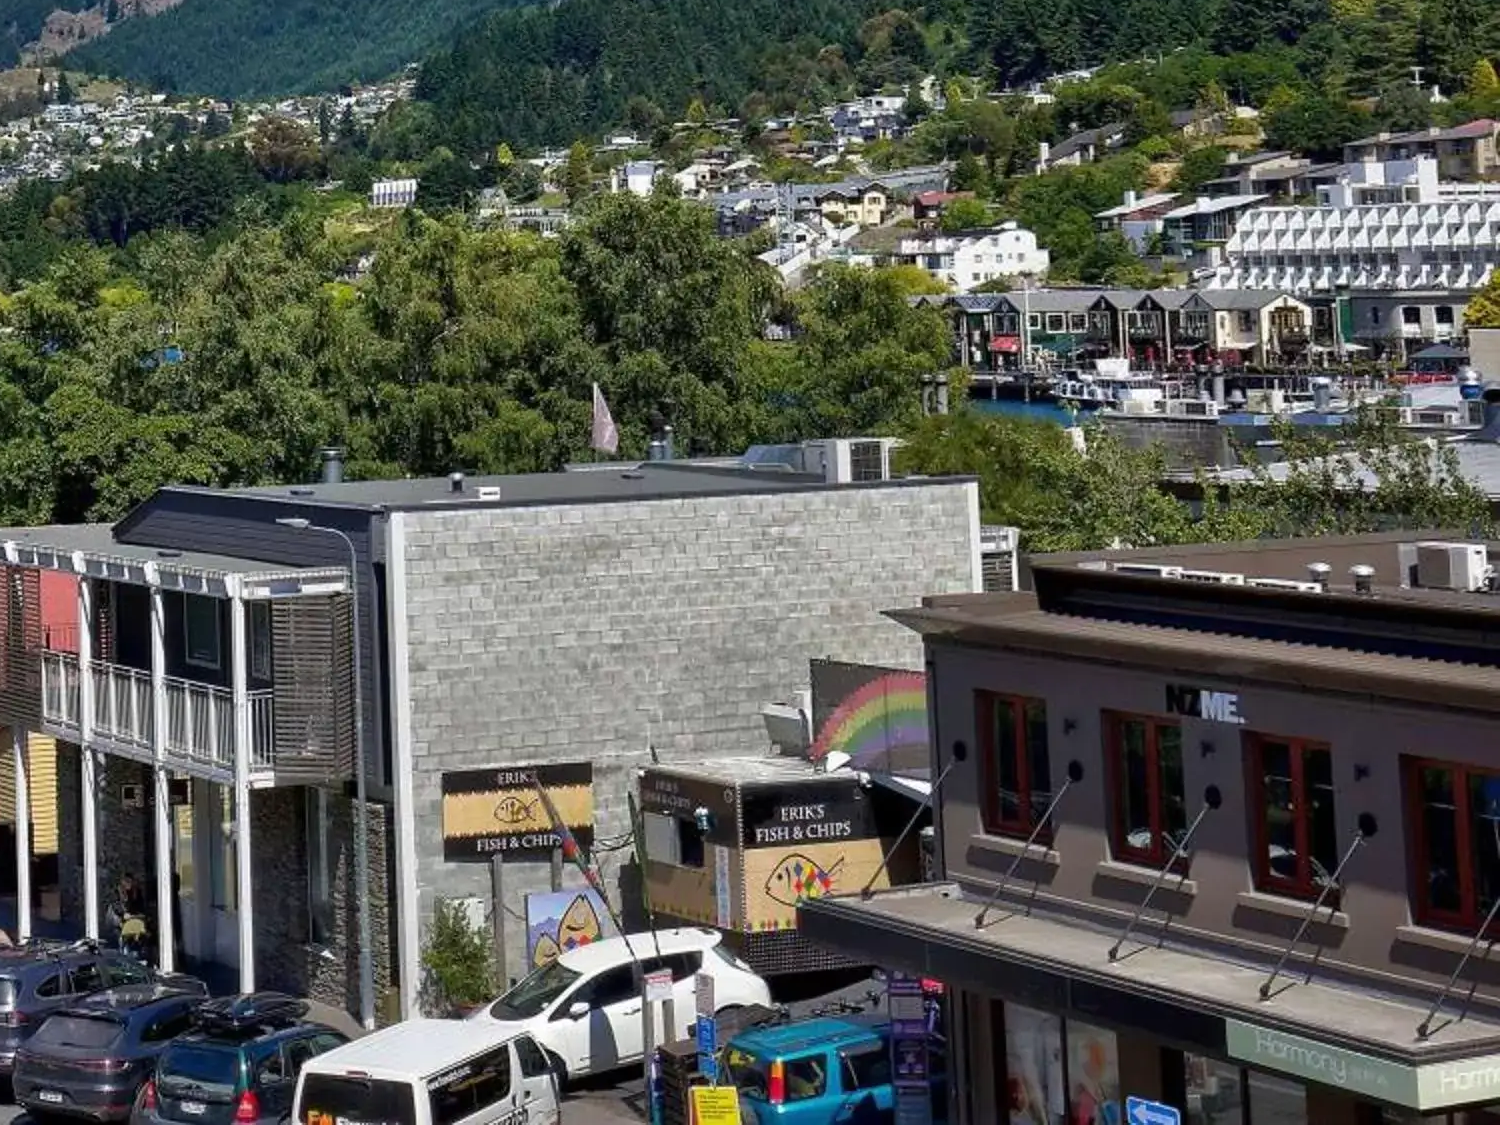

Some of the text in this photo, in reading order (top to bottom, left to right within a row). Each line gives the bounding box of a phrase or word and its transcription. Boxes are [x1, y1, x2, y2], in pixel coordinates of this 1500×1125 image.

[780, 804, 825, 822] ERIK'S
[756, 821, 851, 843] FISH & CHIPS
[476, 837, 507, 852] FISH
[510, 836, 521, 848] &
[1254, 1029, 1348, 1084] Harmony
